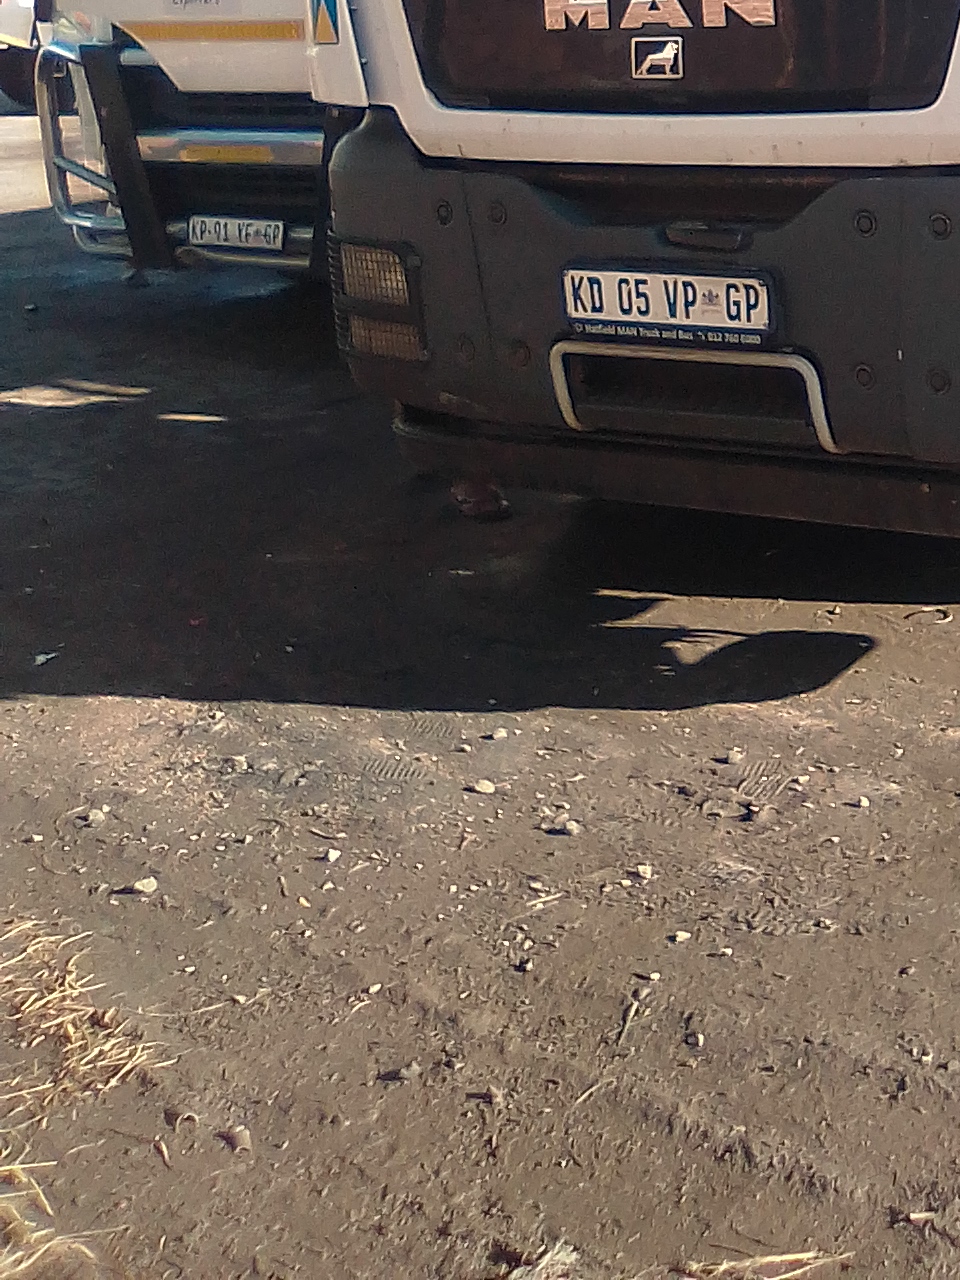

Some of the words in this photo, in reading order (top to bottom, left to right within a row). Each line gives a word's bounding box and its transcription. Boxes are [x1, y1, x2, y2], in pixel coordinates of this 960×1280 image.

[263, 224, 280, 245] GP
[570, 275, 604, 314] KD
[617, 278, 650, 317] 05
[663, 279, 698, 320] VP
[725, 282, 760, 323] GP
